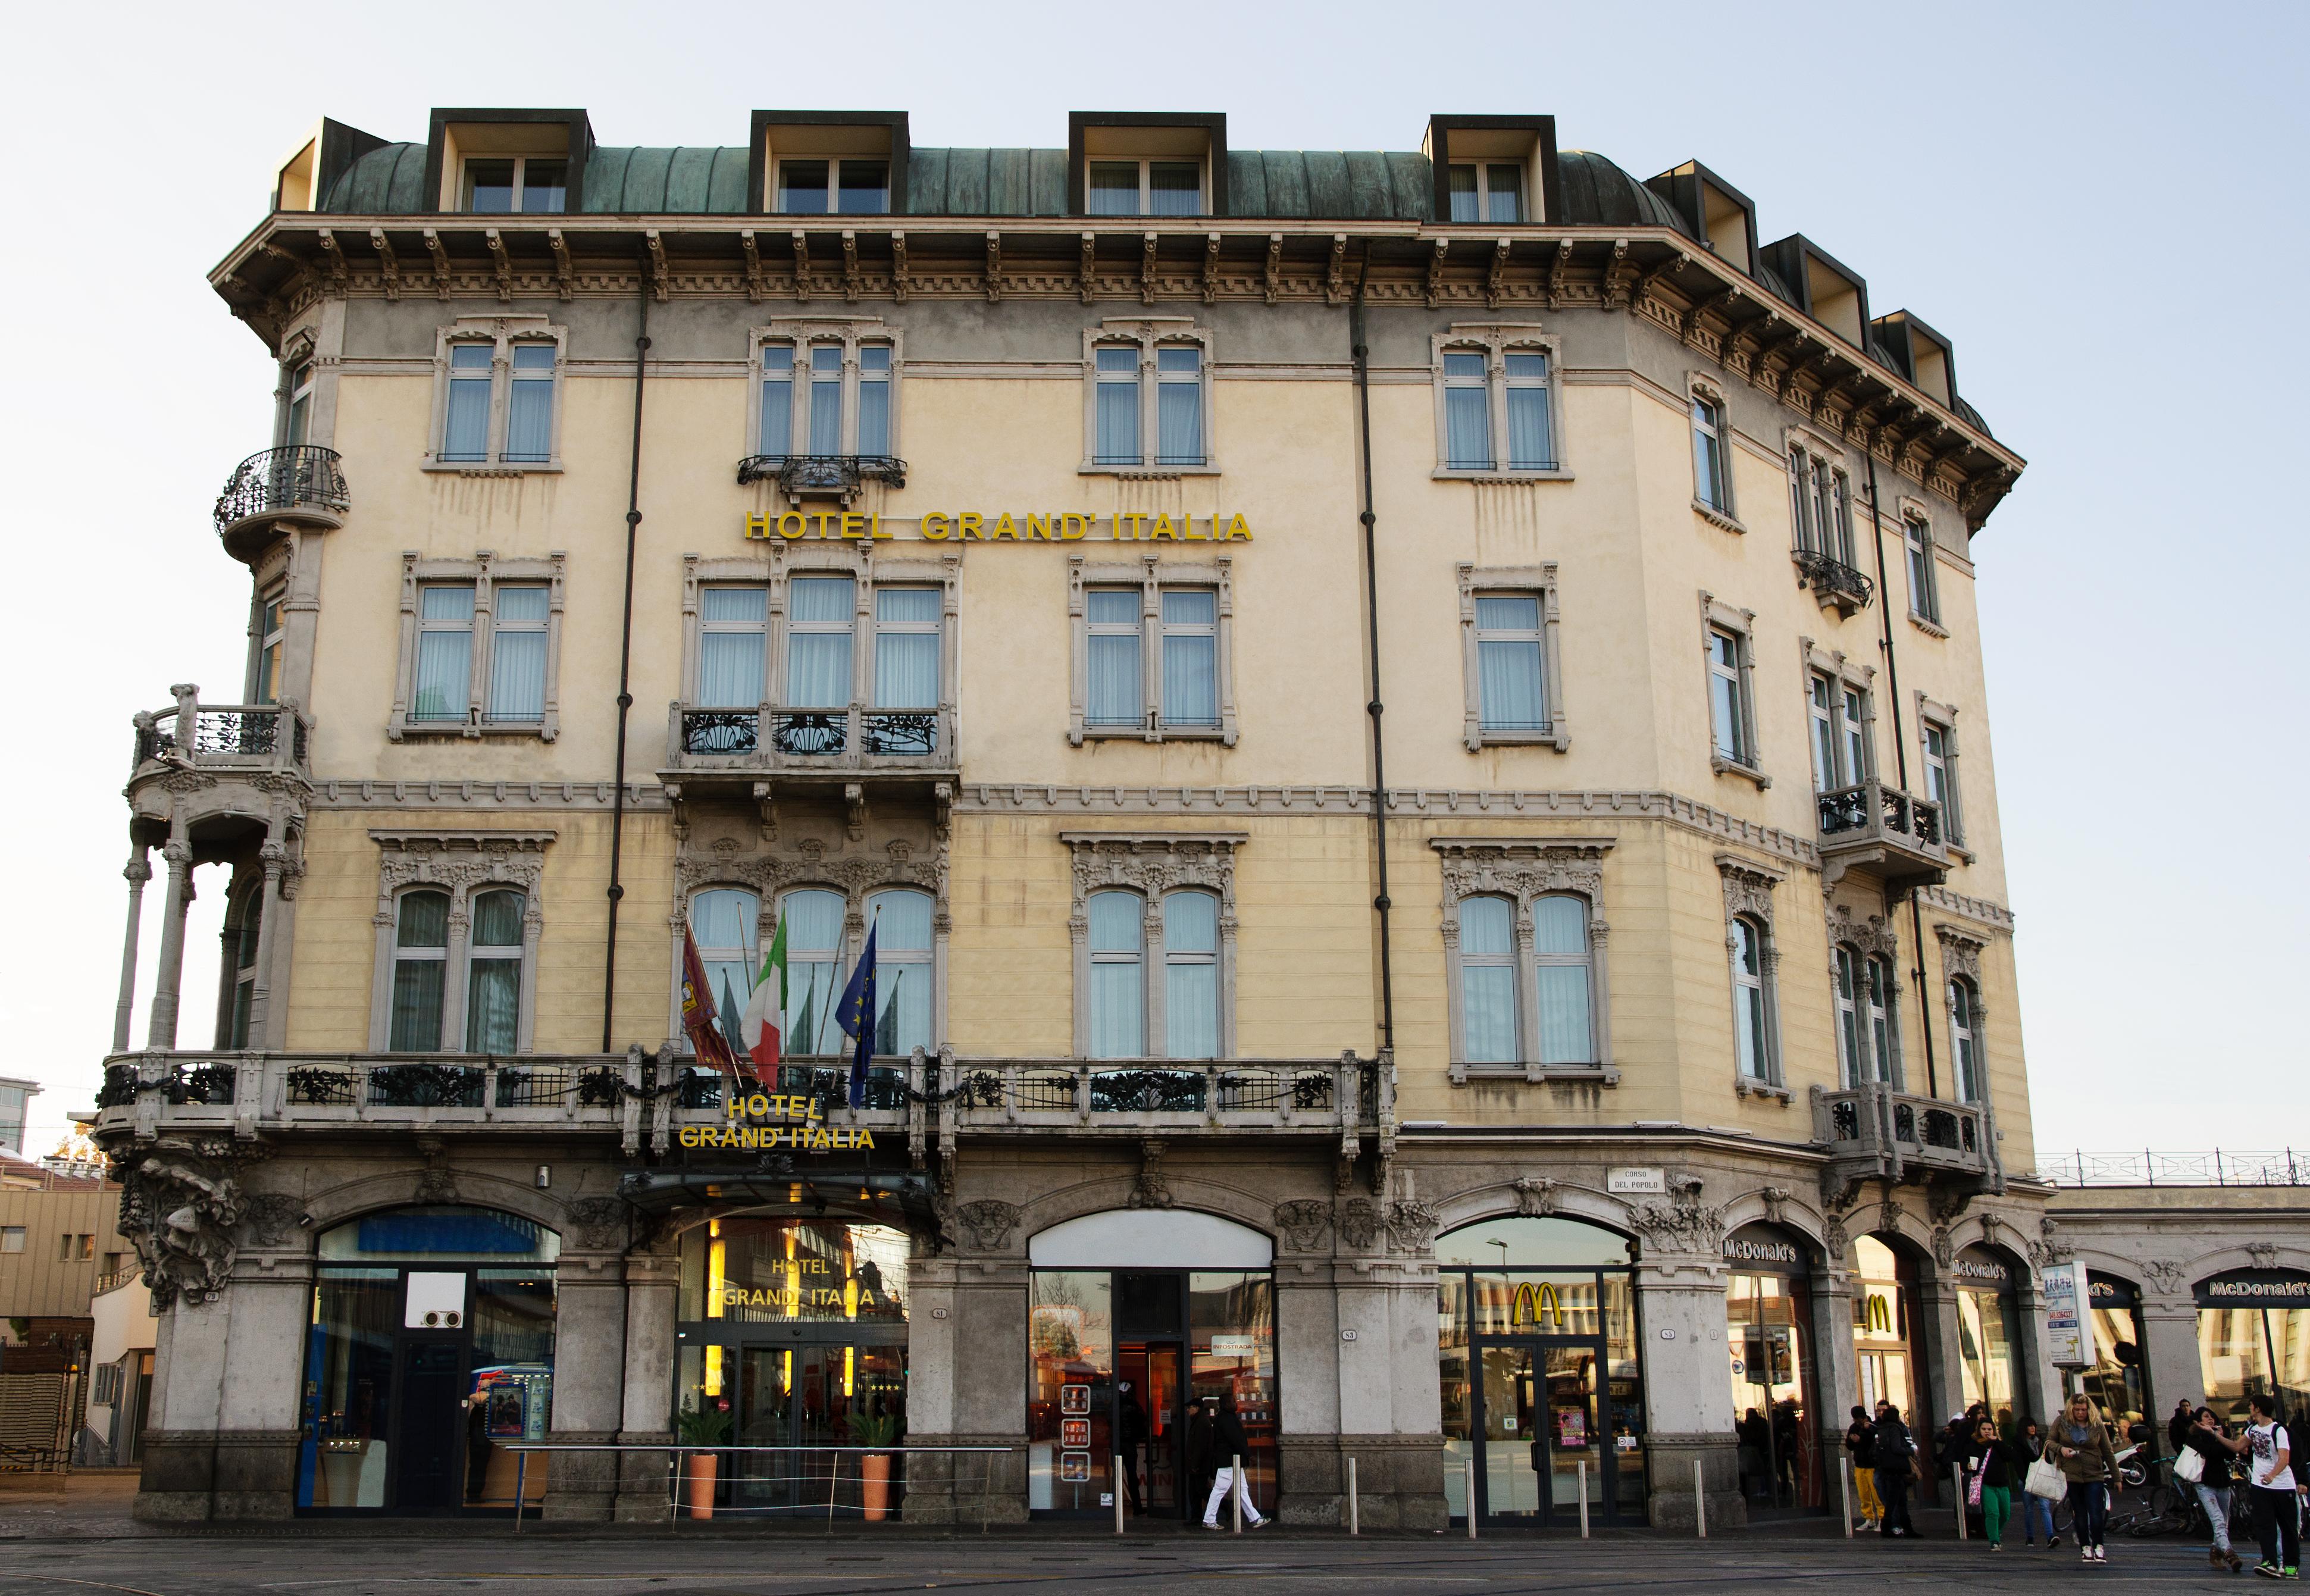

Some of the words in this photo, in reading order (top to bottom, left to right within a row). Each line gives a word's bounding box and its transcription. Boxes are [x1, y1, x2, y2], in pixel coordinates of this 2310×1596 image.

[745, 511, 893, 540] HOTEL
[921, 511, 1096, 540] GRAND'
[1113, 512, 1253, 541] ITALIA
[728, 1094, 823, 1120] HOTEL
[680, 1126, 784, 1149] GRAND'
[791, 1127, 875, 1149] ITALIA
[1723, 1238, 1796, 1262] McDonald's
[772, 1259, 830, 1274] HOTEL
[1951, 1259, 2006, 1280] McDonald's
